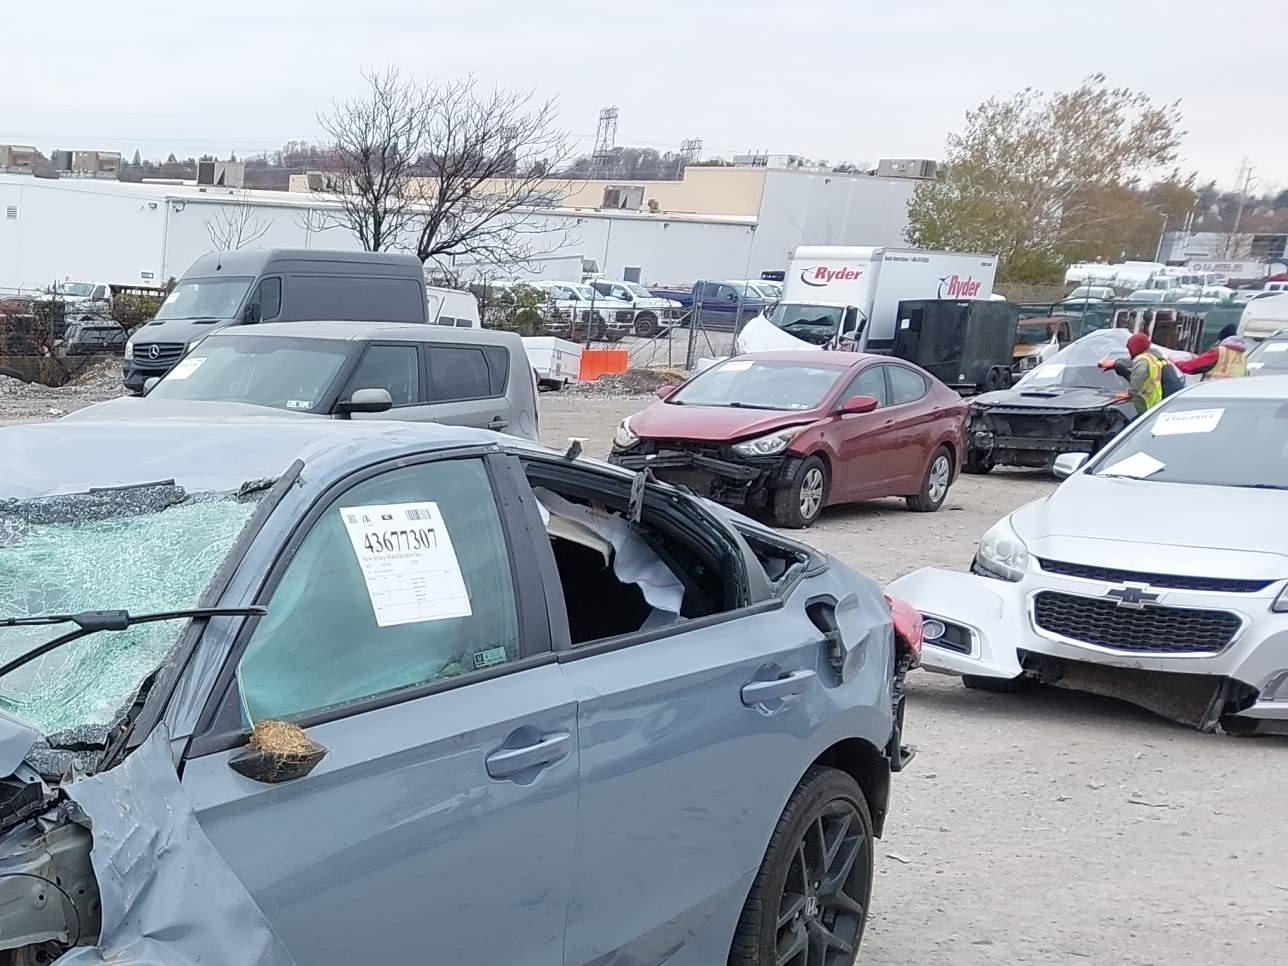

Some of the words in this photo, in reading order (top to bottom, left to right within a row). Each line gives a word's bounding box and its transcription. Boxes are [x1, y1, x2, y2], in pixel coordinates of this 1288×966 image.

[814, 266, 863, 282] Ryder
[947, 274, 982, 299] Ryder
[364, 527, 438, 553] 43677307
